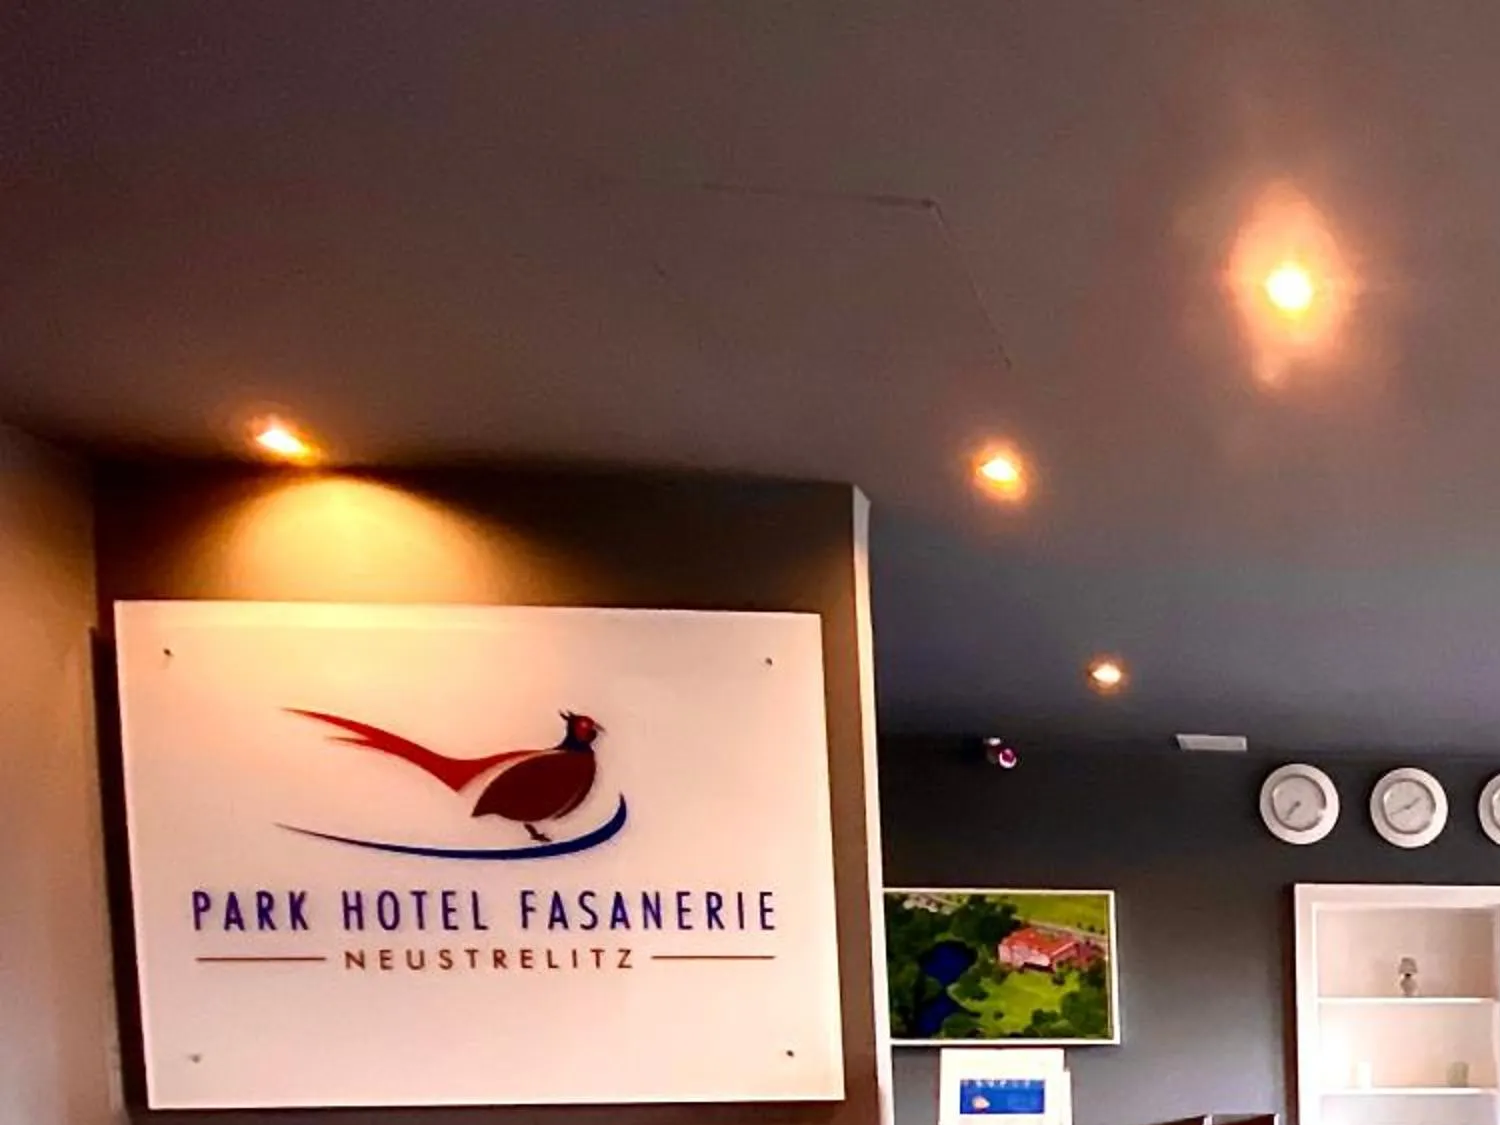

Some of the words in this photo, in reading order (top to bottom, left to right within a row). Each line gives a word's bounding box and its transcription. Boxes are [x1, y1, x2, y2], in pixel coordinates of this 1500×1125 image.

[191, 890, 310, 932] PARK
[341, 890, 489, 932] HOTEL
[519, 889, 776, 931] FASANERIE
[344, 948, 633, 971] NEUSTRELITZ
